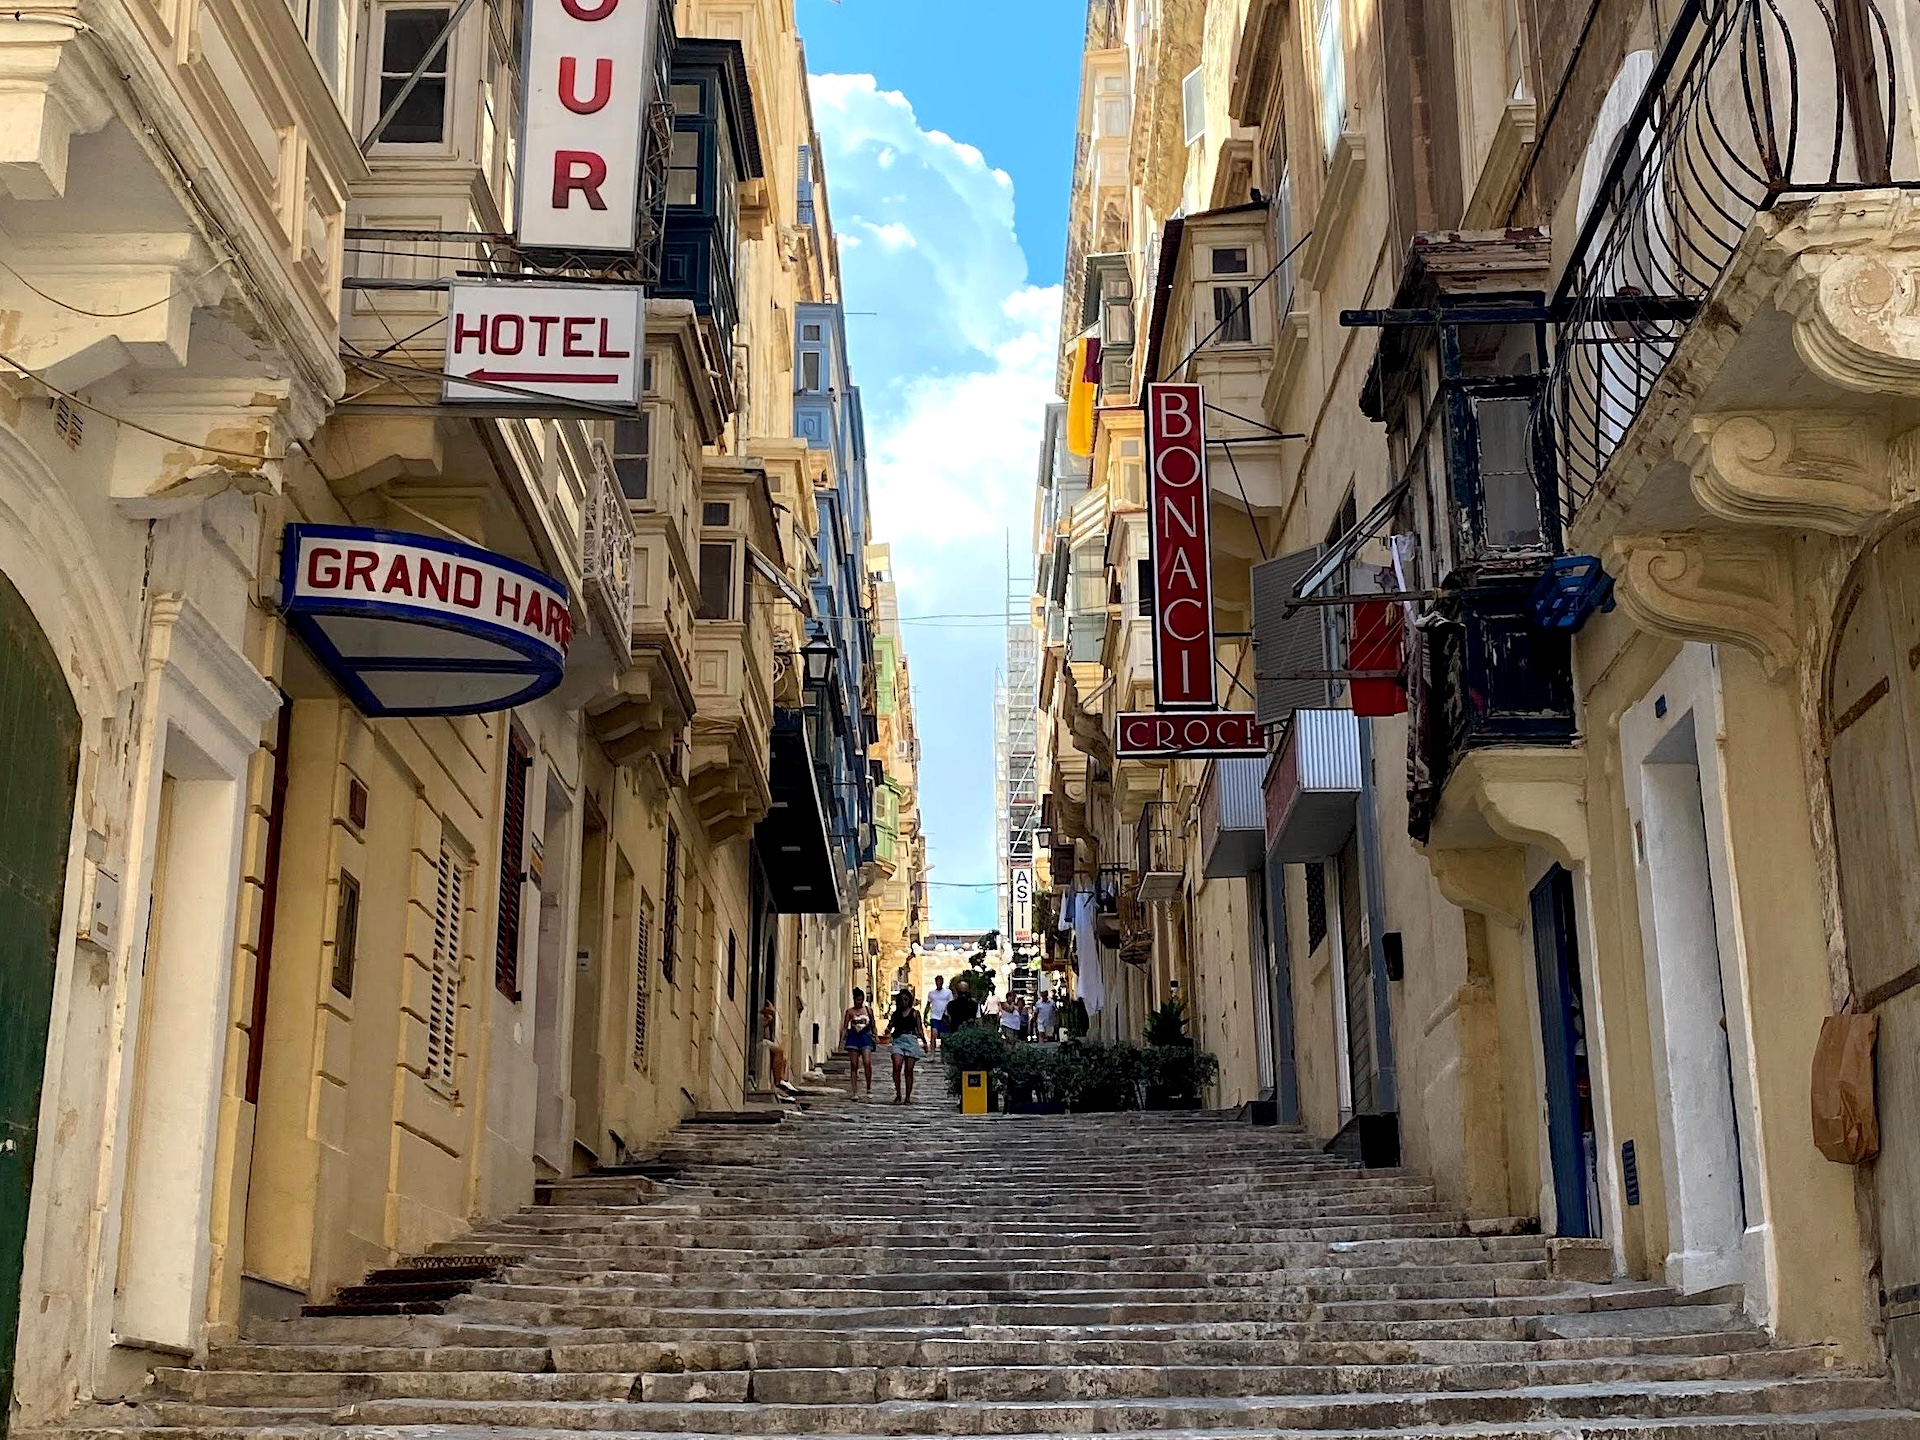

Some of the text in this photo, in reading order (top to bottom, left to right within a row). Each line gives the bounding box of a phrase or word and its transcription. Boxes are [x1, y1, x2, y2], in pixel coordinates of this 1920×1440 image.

[454, 313, 630, 358] HOTEL
[1156, 392, 1204, 694] BONACI
[308, 548, 482, 609] GRAND
[1126, 719, 1260, 750] CROCE
[1016, 870, 1029, 929] ASTI
